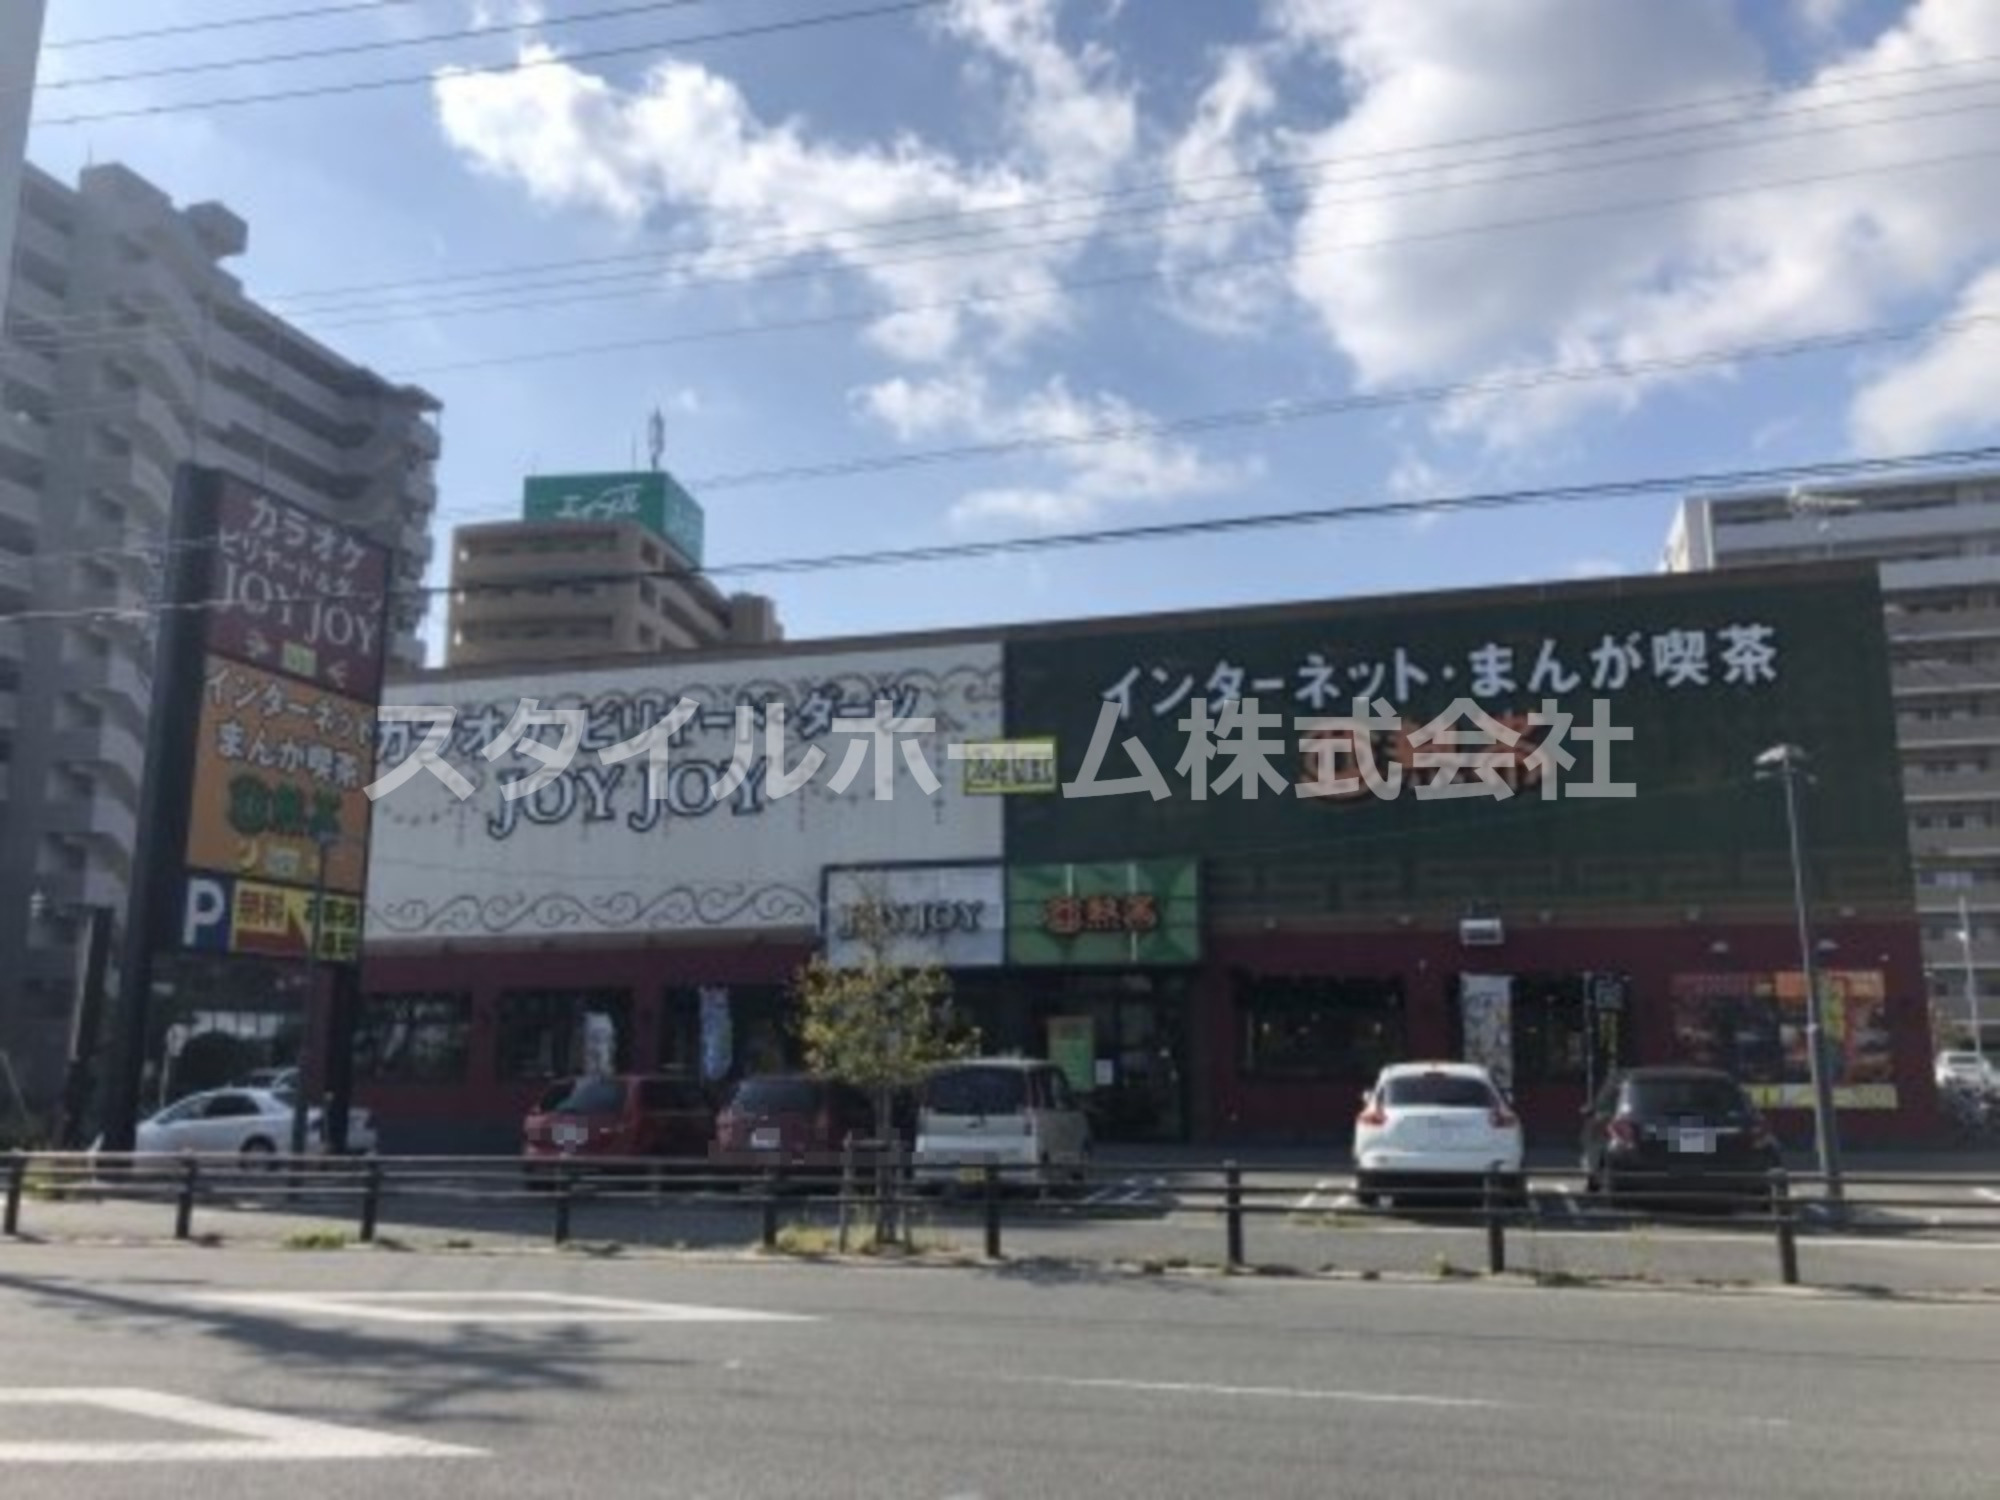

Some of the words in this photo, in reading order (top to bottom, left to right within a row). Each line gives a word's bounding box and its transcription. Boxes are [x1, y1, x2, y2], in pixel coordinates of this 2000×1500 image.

[251, 496, 366, 572] カラオケ
[216, 561, 298, 628] JOY
[302, 600, 379, 653] JOY
[487, 763, 627, 841] JOY
[627, 755, 773, 833] JOY
[182, 877, 226, 946] P
